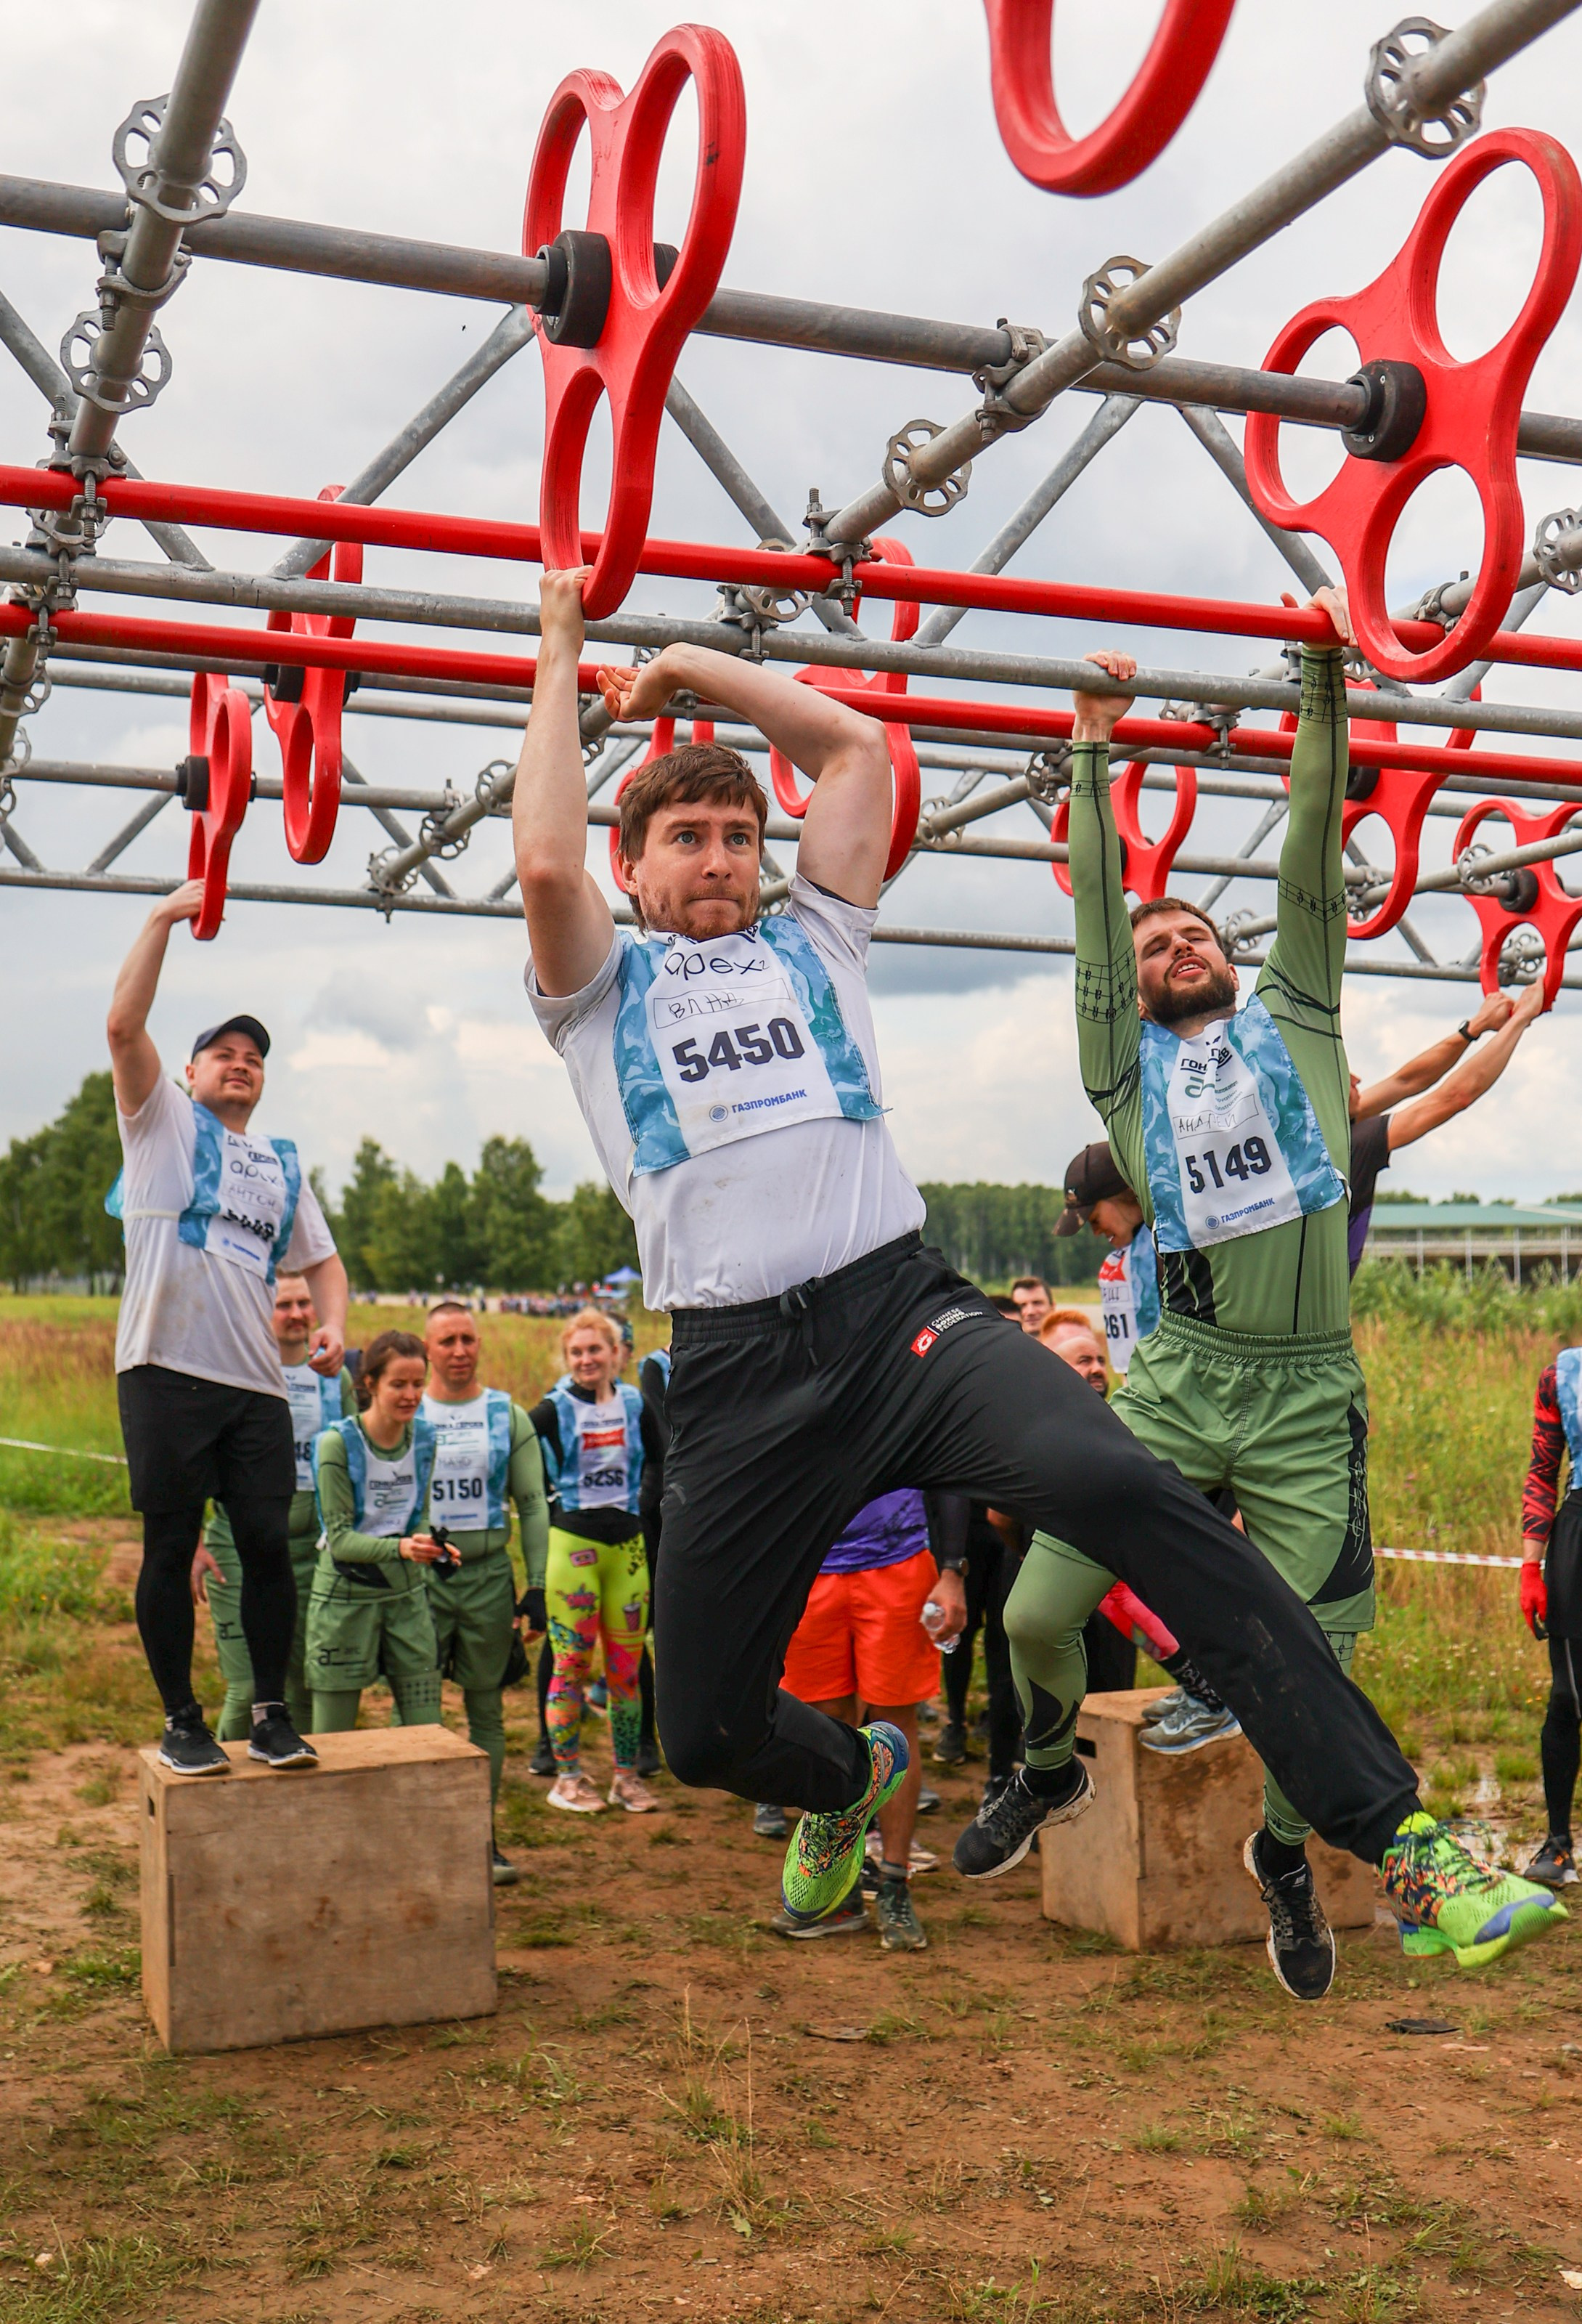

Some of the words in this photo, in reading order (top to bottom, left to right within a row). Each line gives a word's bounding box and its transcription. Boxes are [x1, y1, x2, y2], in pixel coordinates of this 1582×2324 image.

[672, 1017, 805, 1083] 5450
[731, 1089, 807, 1114] ГАЗПРОМБАНК
[1185, 1136, 1272, 1194] 5149
[1221, 1197, 1275, 1223] ГАЗПРОМБАНК
[931, 1307, 960, 1327] CHINESE
[935, 1311, 965, 1330] BOXING
[939, 1311, 983, 1333] FEDERATION
[1104, 1313, 1130, 1338] 261
[432, 1477, 483, 1501] 5150
